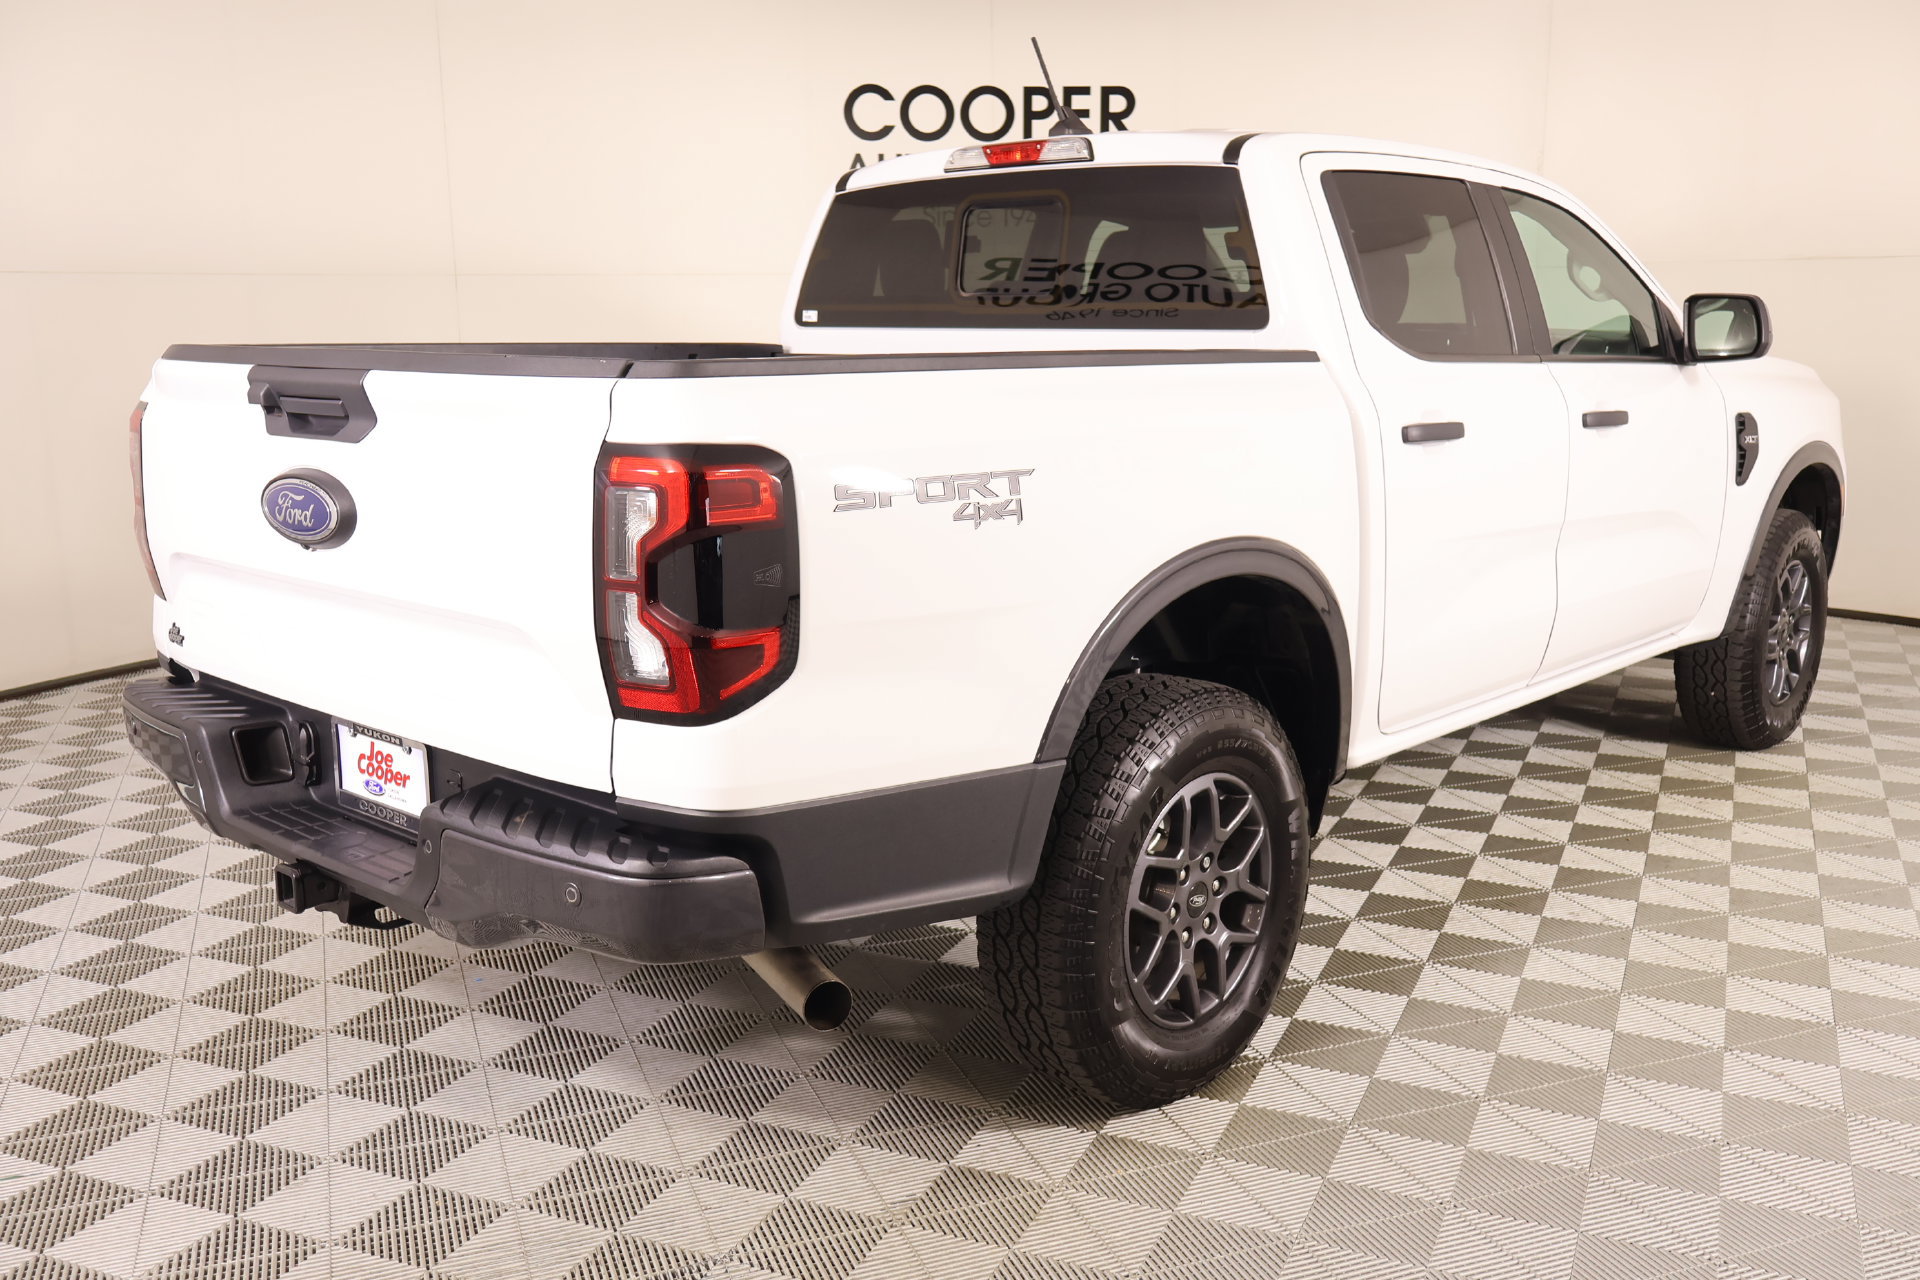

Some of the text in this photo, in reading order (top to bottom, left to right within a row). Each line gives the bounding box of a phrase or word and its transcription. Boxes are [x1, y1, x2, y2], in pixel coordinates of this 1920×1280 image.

[833, 468, 1036, 512] SPORT
[275, 491, 314, 526] Ford
[953, 498, 1024, 530] 4x4
[355, 725, 401, 745] YUKON
[357, 753, 411, 788] Cooper
[367, 741, 393, 768] Joe
[359, 799, 407, 826] COOPER
